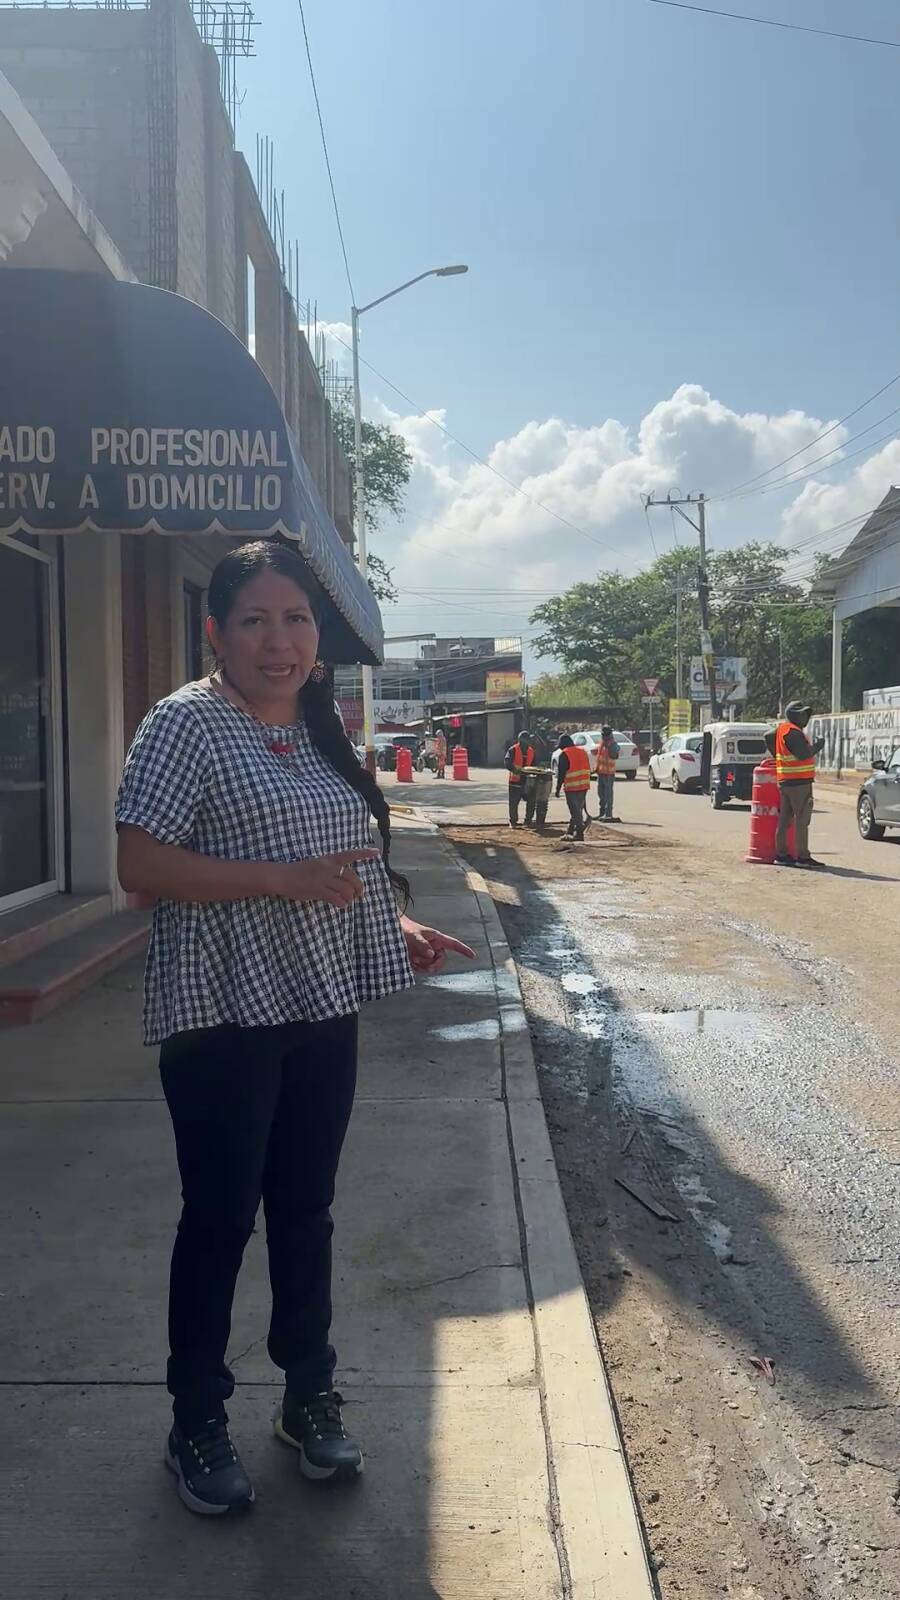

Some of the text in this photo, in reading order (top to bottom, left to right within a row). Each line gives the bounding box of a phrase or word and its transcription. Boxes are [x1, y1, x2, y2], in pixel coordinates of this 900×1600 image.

[0, 426, 287, 467] ADO PROFESIONAL
[78, 474, 99, 509] A
[127, 473, 281, 511] DOMICILIO
